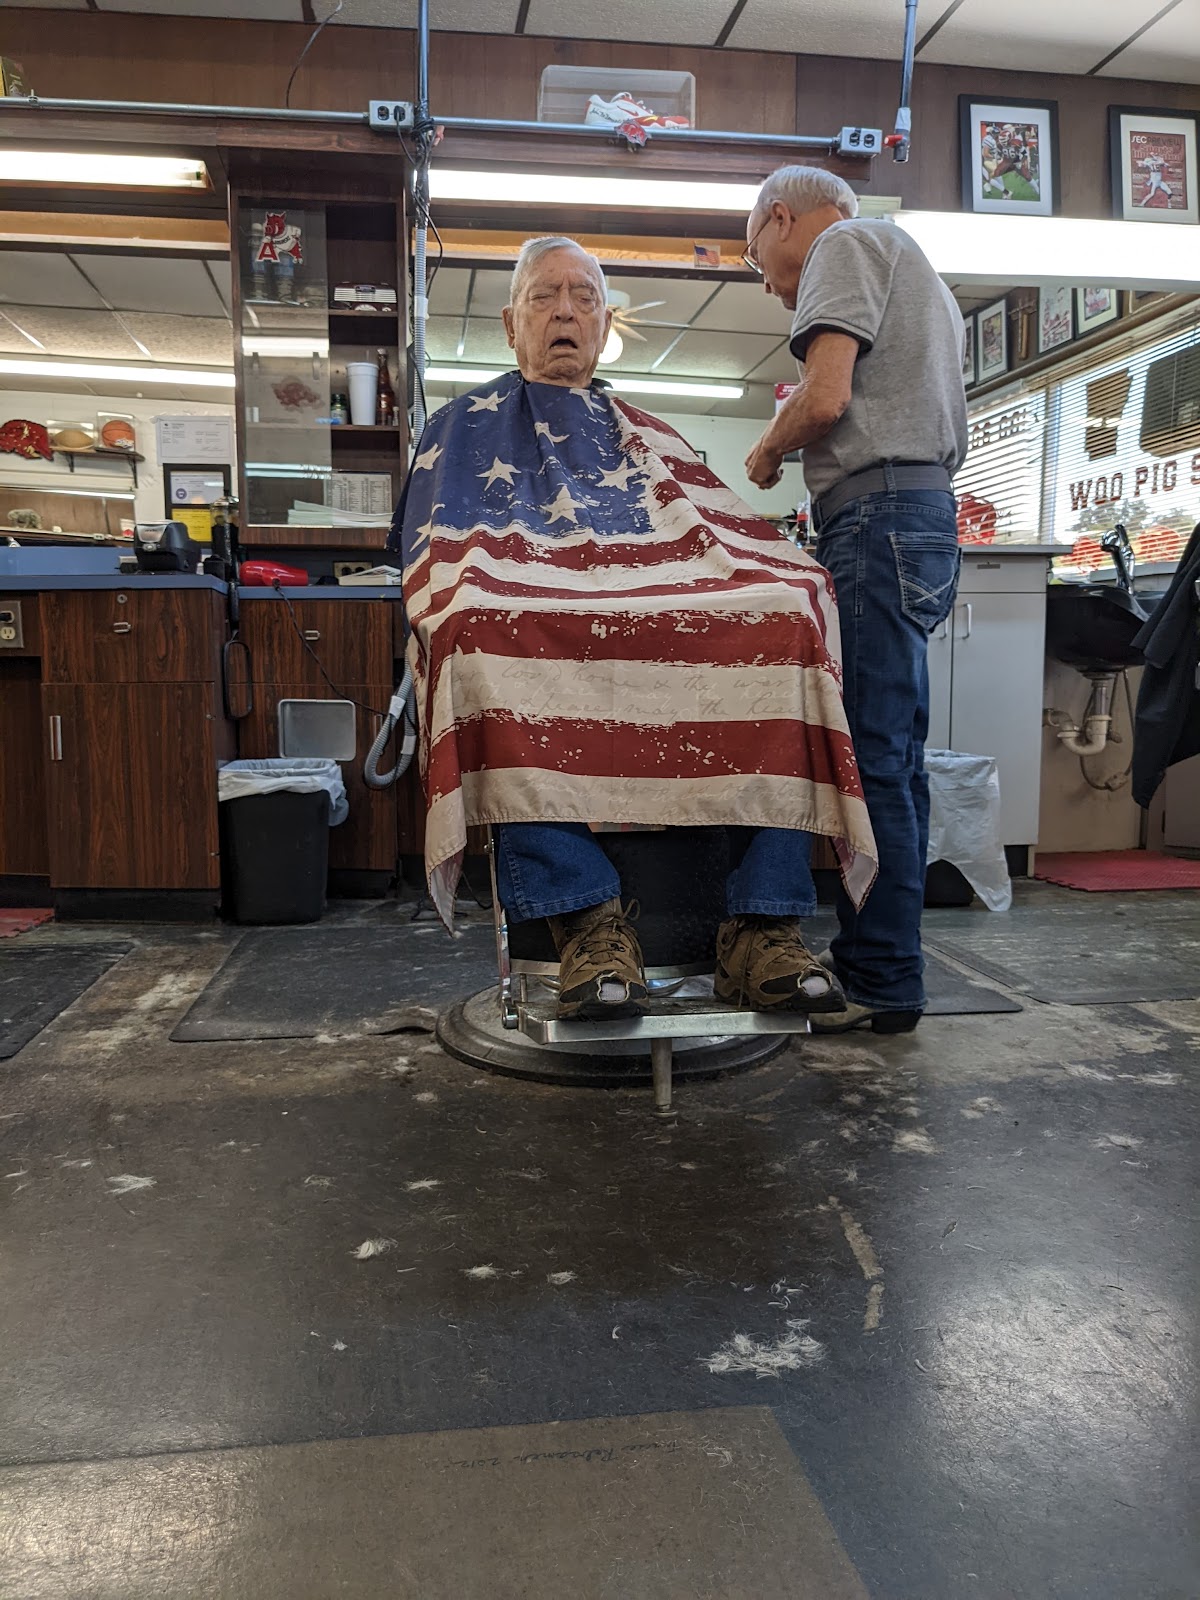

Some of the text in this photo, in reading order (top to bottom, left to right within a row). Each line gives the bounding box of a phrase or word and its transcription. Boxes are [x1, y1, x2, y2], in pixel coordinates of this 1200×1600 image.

[1131, 135, 1147, 144] SEC
[1068, 472, 1123, 511] WOO
[1134, 460, 1178, 497] PIG
